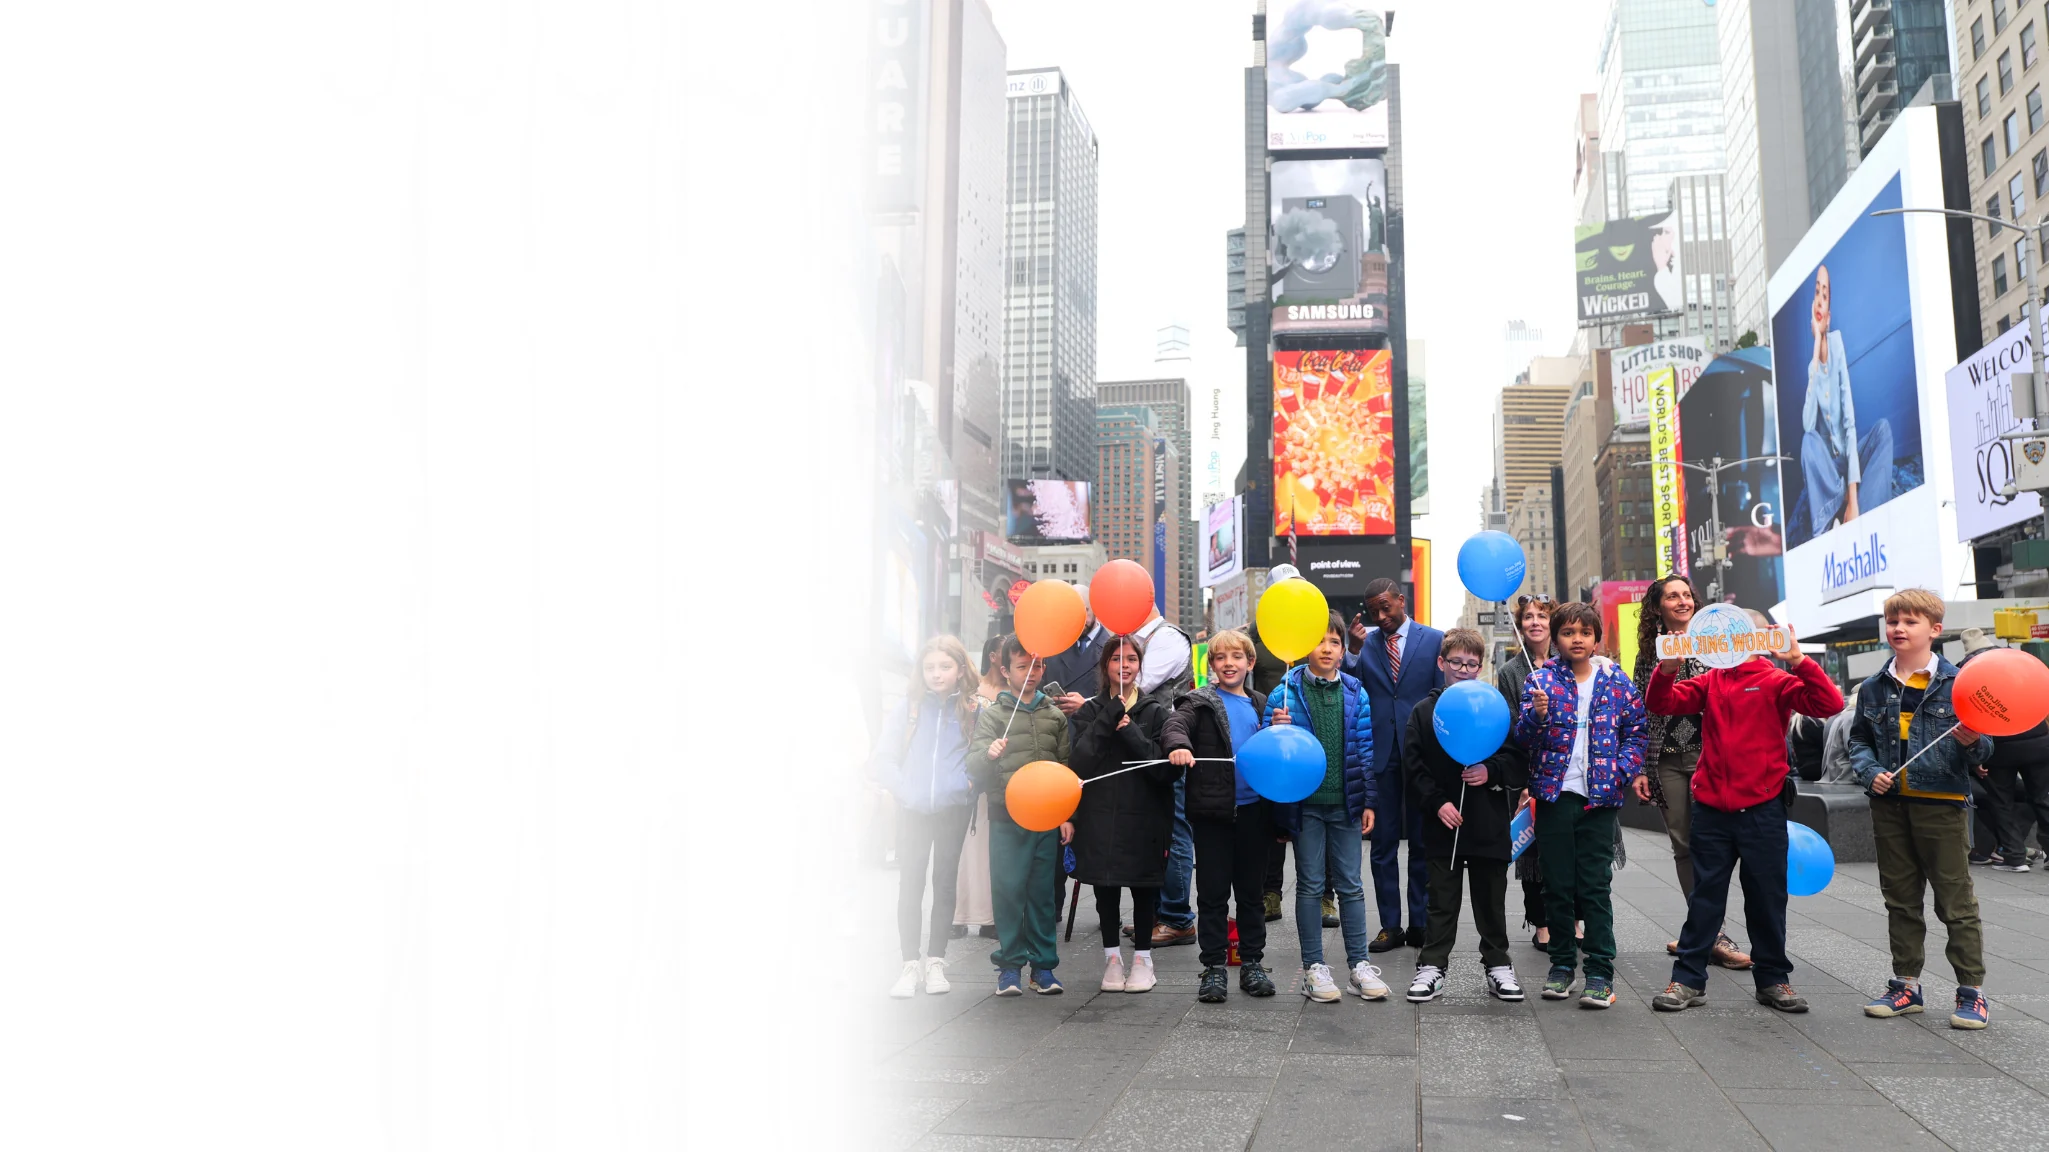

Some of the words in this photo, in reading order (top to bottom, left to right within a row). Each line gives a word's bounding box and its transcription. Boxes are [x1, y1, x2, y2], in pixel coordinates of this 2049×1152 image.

[876, 0, 909, 175] UARE
[1584, 273, 1616, 285] Brains.
[1618, 269, 1646, 281] Heart.
[1596, 280, 1636, 292] Courage.
[1288, 304, 1374, 320] SAMSUNG
[1622, 345, 1665, 374] LITTLE
[1669, 344, 1702, 362] SHOP
[1211, 388, 1221, 419] Huang
[1656, 384, 1668, 445] WORLD'S
[1211, 422, 1221, 440] Jing
[1659, 448, 1669, 481] BEST
[1661, 485, 1672, 539] SPORTS
[1751, 502, 1774, 528] G
[1310, 560, 1331, 571] point
[1331, 560, 1341, 569] of
[1340, 560, 1361, 569] view.
[1821, 532, 1887, 592] Marshalls
[1662, 636, 1692, 656] GAN
[1695, 633, 1729, 655] JING
[1731, 630, 1785, 653] WORLD
[1975, 690, 2011, 723] World.com
[1981, 685, 2008, 713] GanJing
